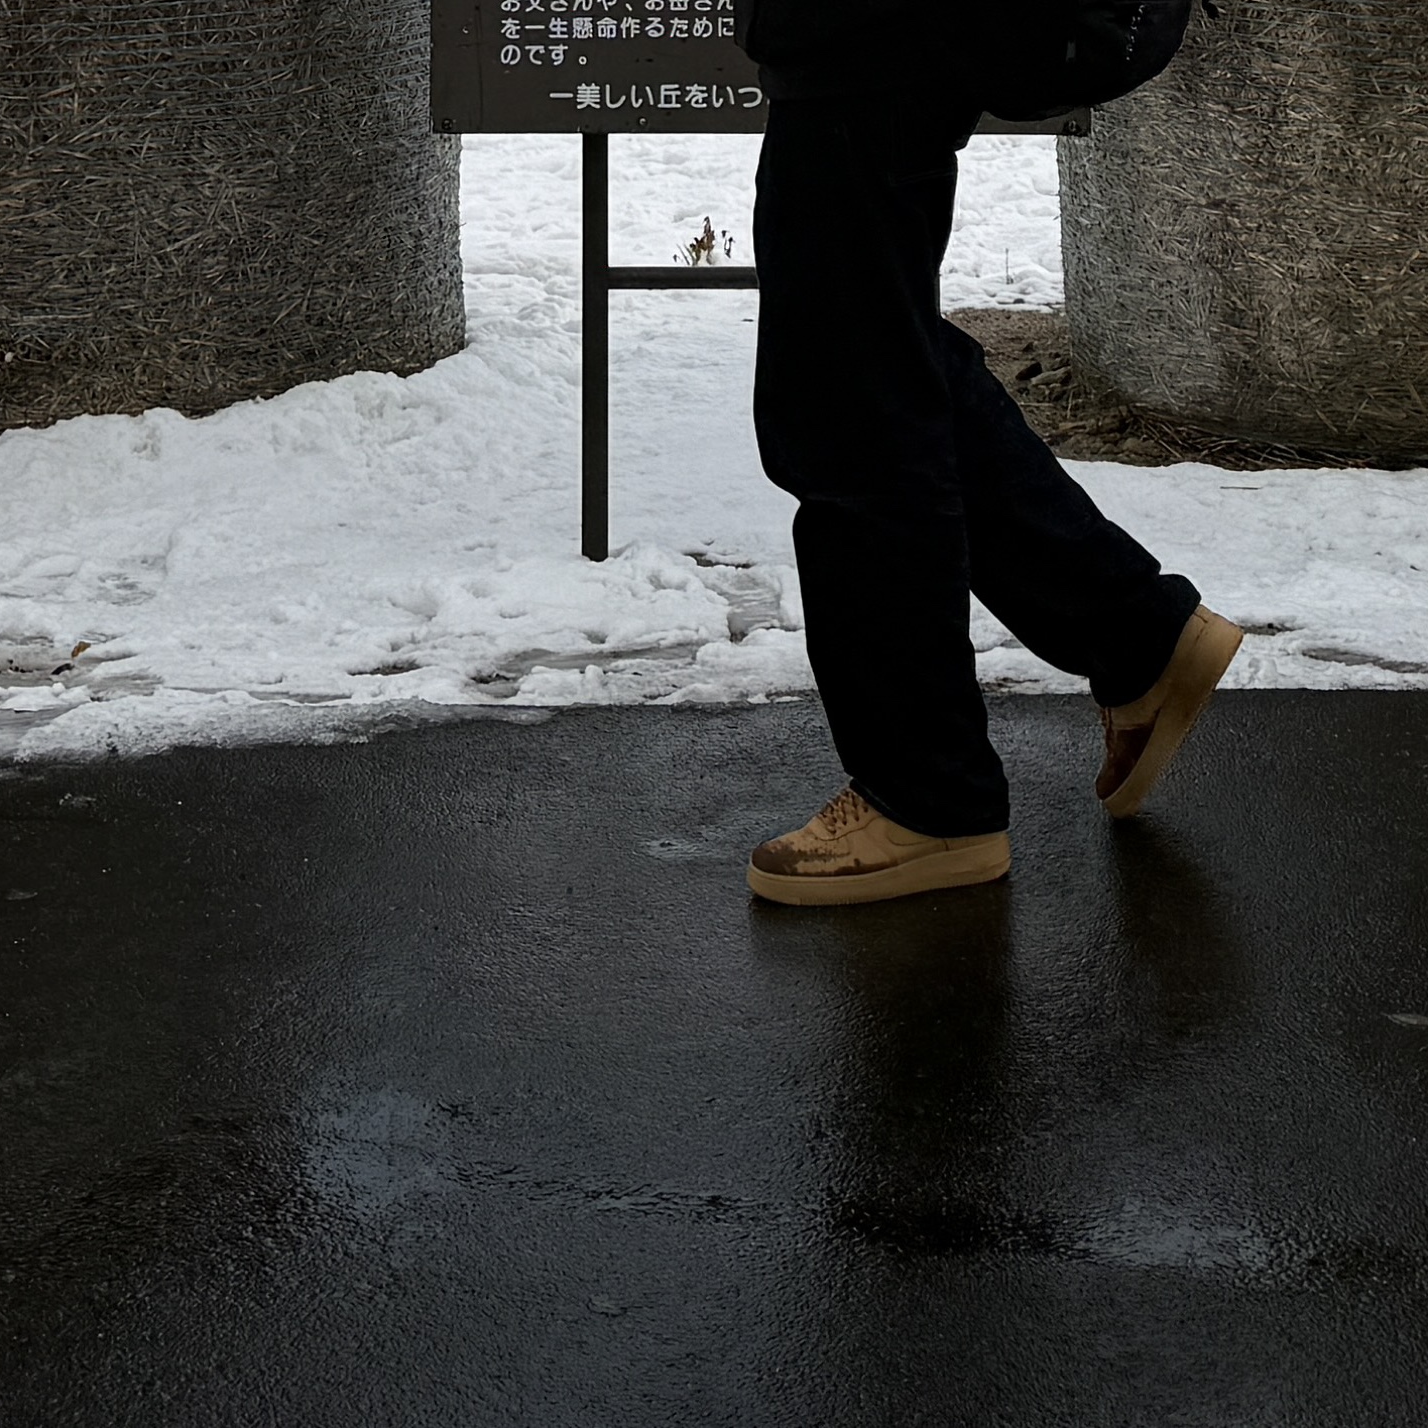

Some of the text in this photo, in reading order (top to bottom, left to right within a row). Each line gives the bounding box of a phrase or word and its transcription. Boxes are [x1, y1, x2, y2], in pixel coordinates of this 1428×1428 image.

[500, 16, 734, 39] を一生懸命作るために
[500, 43, 587, 65] のです。
